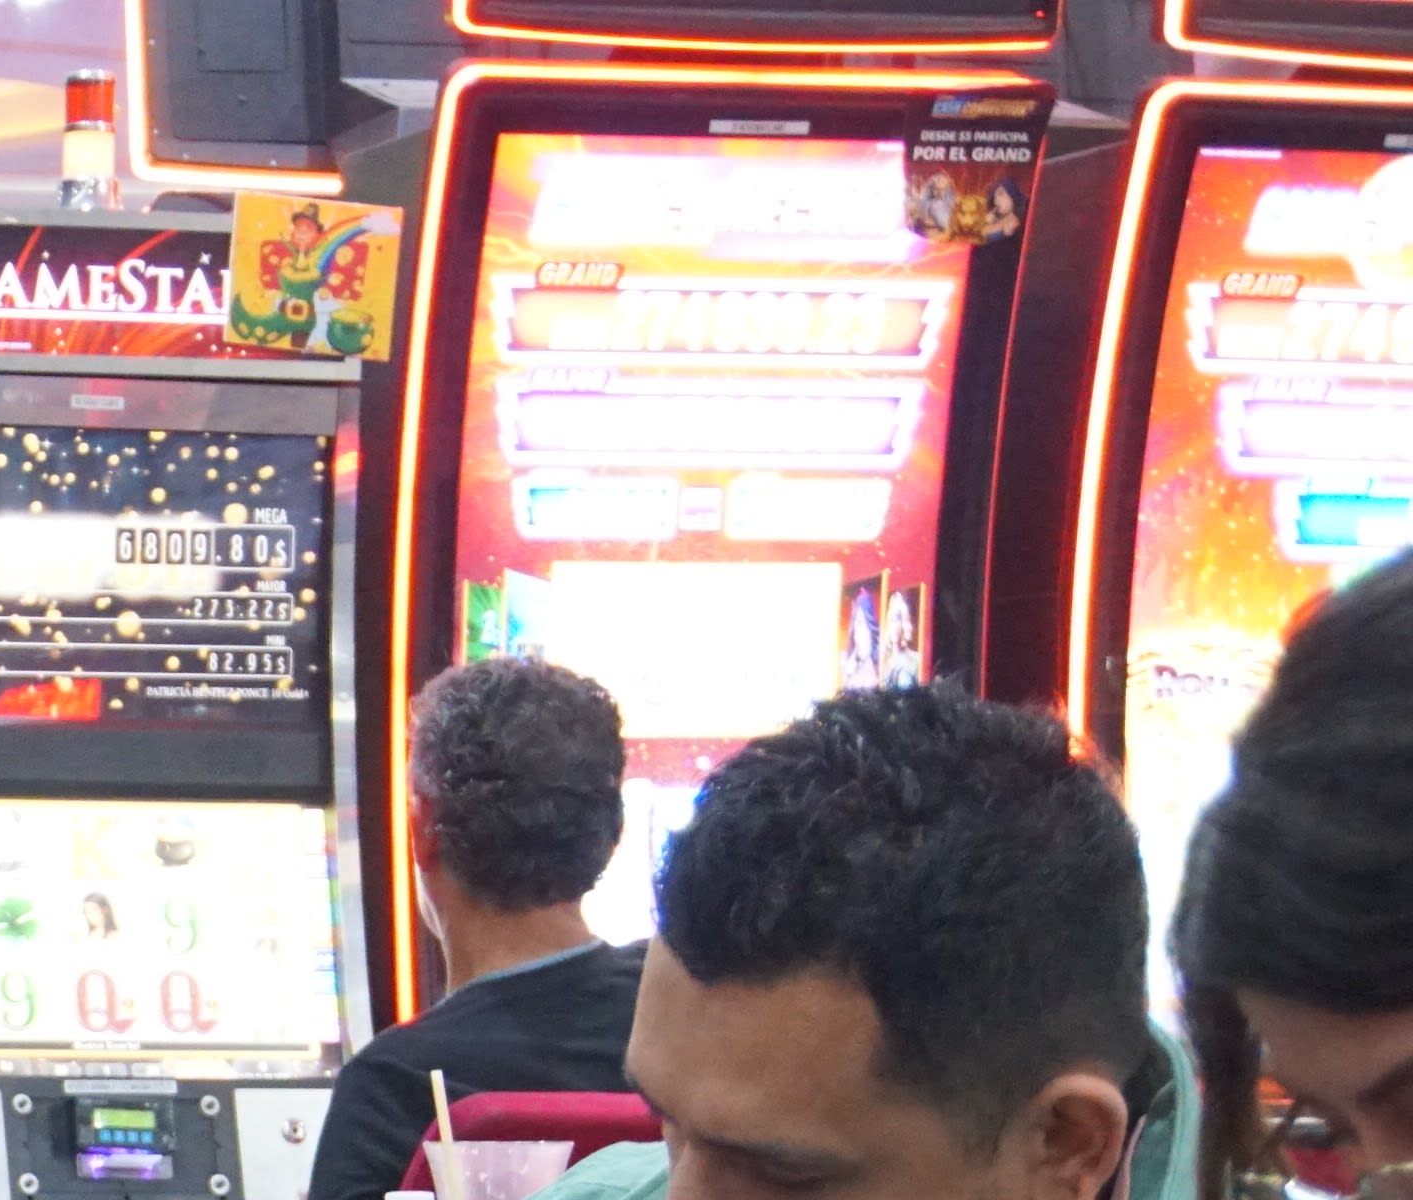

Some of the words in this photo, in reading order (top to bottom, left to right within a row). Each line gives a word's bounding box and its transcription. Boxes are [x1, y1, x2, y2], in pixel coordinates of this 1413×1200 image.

[974, 131, 1029, 143] PARTICIPA
[913, 145, 947, 161] POR
[949, 147, 967, 162] EL
[972, 147, 1032, 163] GRAND
[538, 262, 619, 287] GRAND
[1223, 273, 1299, 297] GRAND
[254, 507, 289, 524] MEGA
[118, 530, 287, 564] 6809.80$
[255, 580, 287, 592] MAYOR
[146, 686, 191, 698] PATRICIA
[163, 896, 200, 955] 9
[0, 969, 37, 1032] 9
